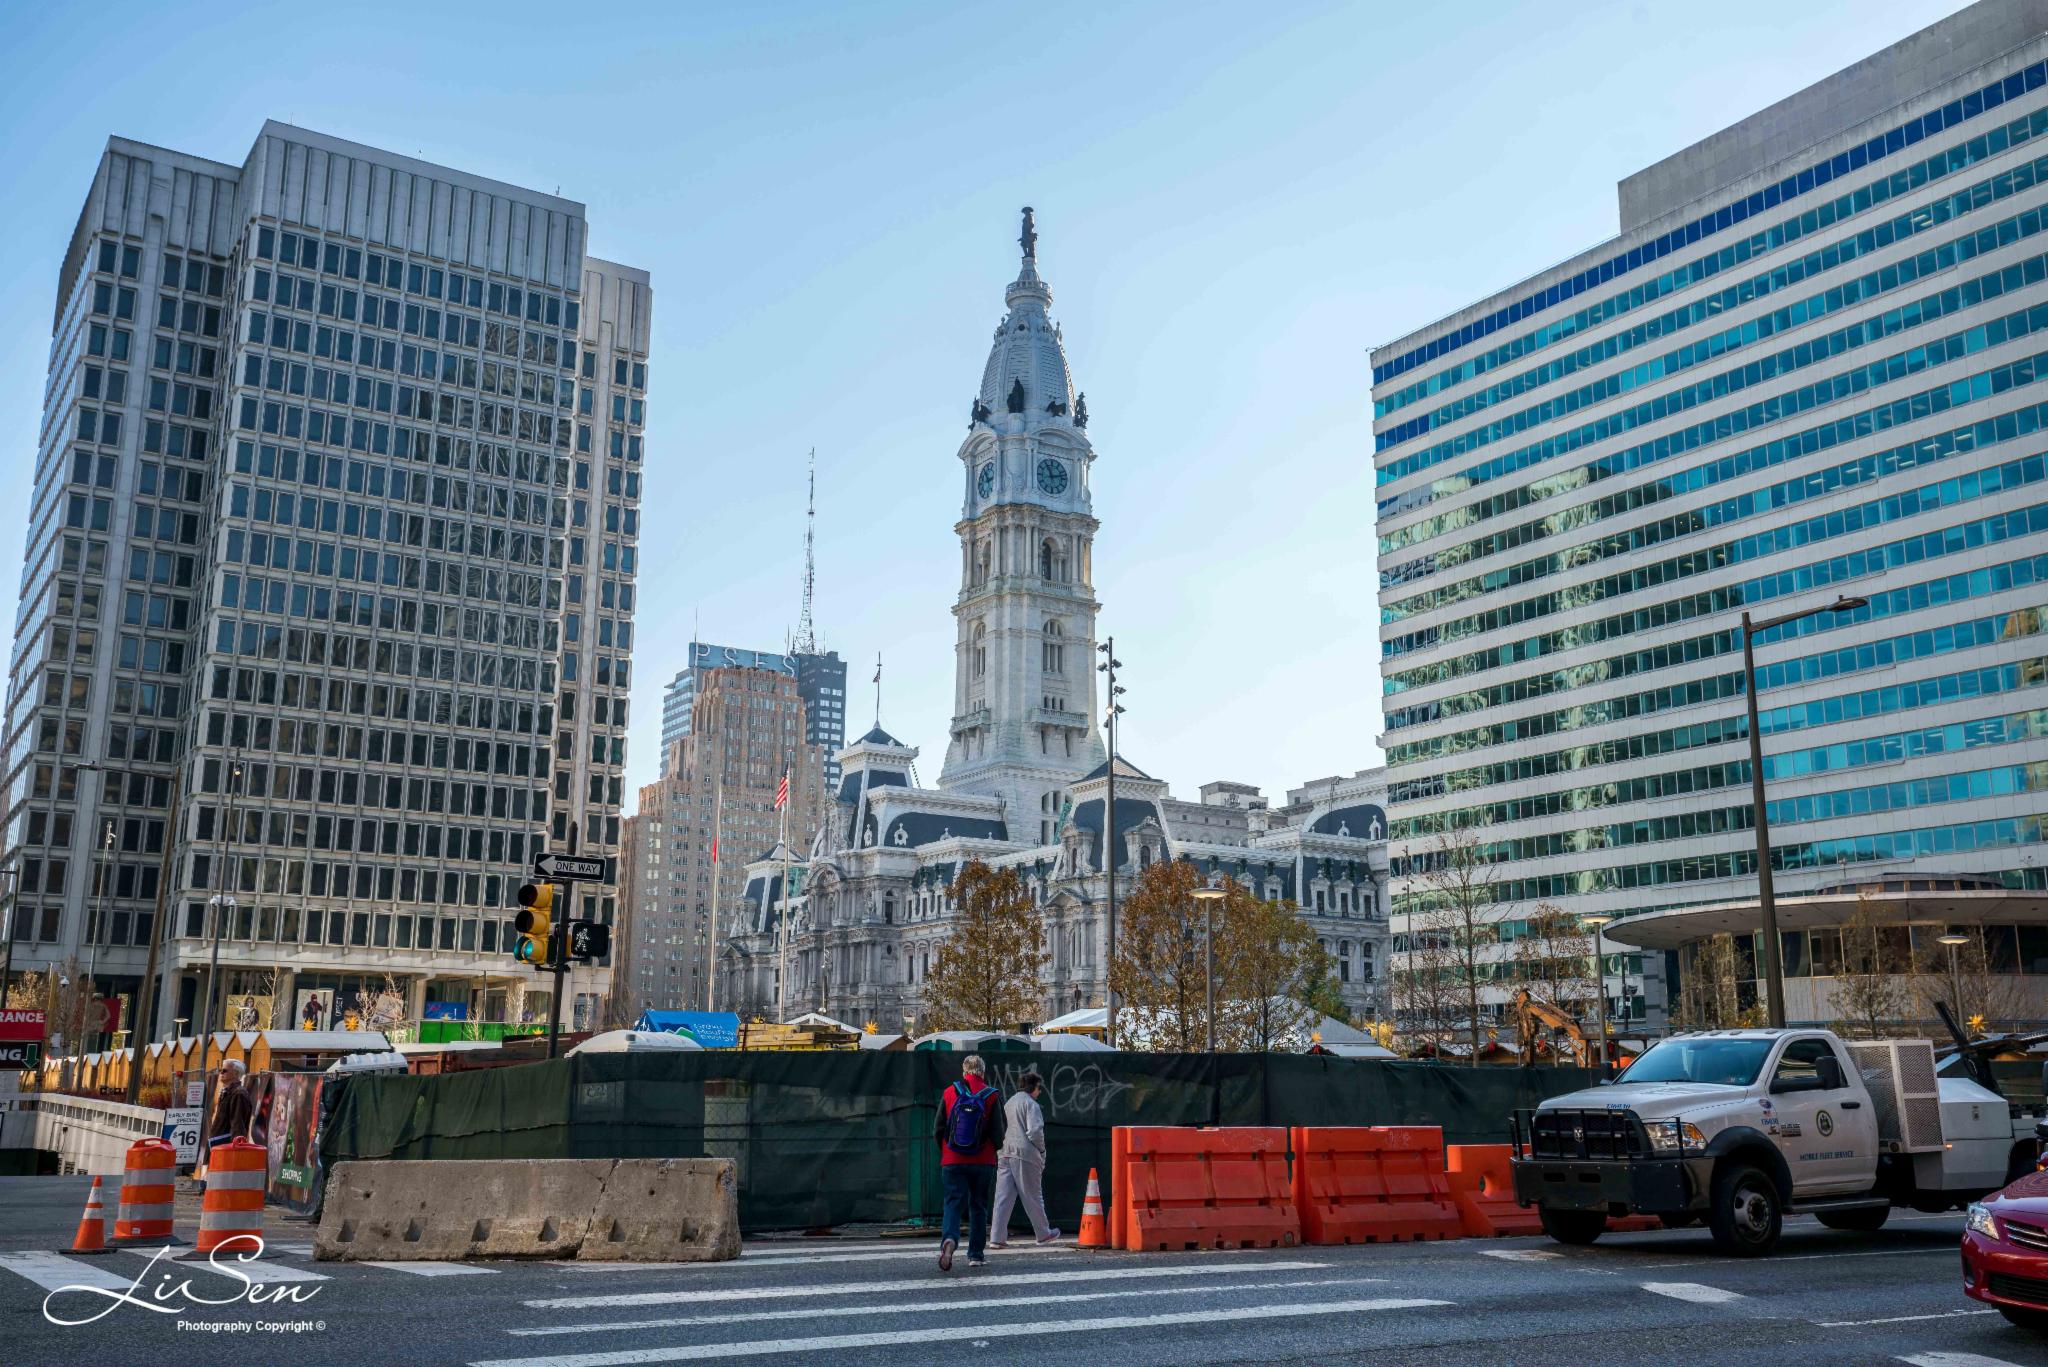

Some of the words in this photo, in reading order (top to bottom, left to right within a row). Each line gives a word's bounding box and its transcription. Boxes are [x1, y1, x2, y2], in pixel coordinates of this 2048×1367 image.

[555, 861, 575, 872] ONE
[578, 863, 598, 873] WAY
[172, 1130, 197, 1146] $16
